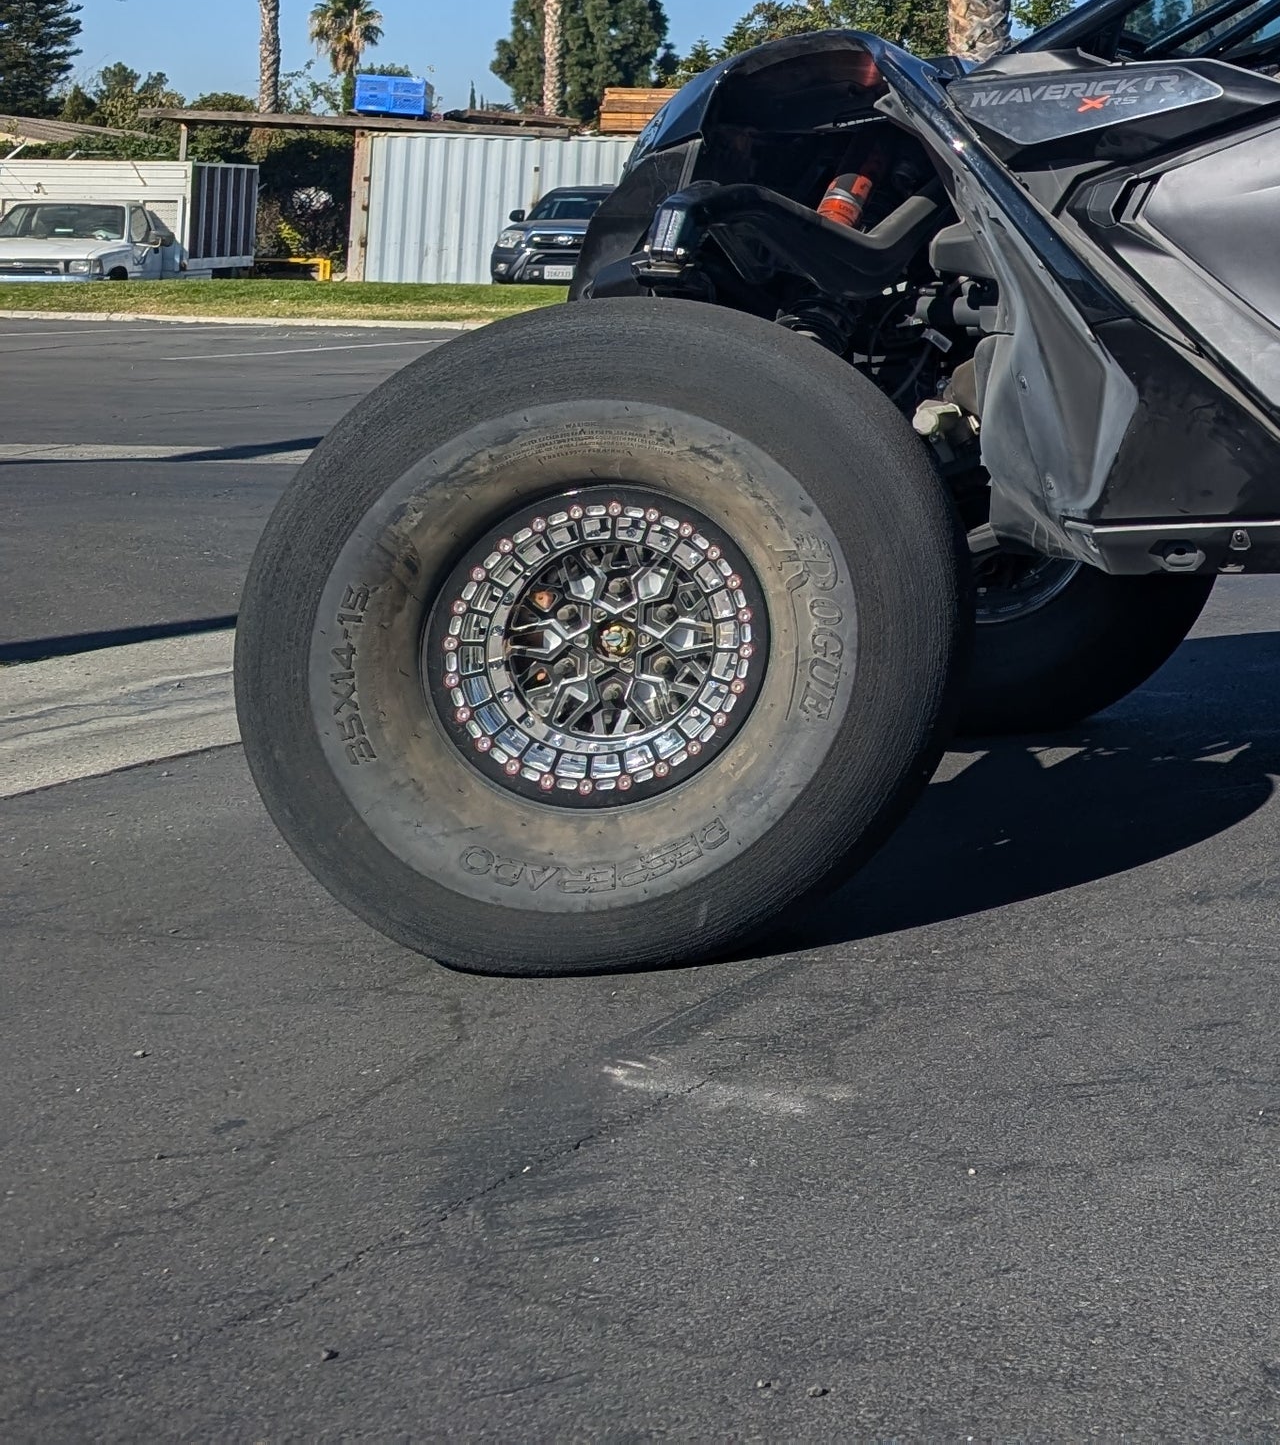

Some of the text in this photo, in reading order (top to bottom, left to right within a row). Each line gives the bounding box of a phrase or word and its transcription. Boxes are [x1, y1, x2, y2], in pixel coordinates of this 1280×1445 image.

[970, 75, 1180, 107] MAVERICK R
[328, 583, 377, 765] 35X14-15
[768, 531, 843, 721] ROGUE
[459, 816, 730, 894] DESPERADO
